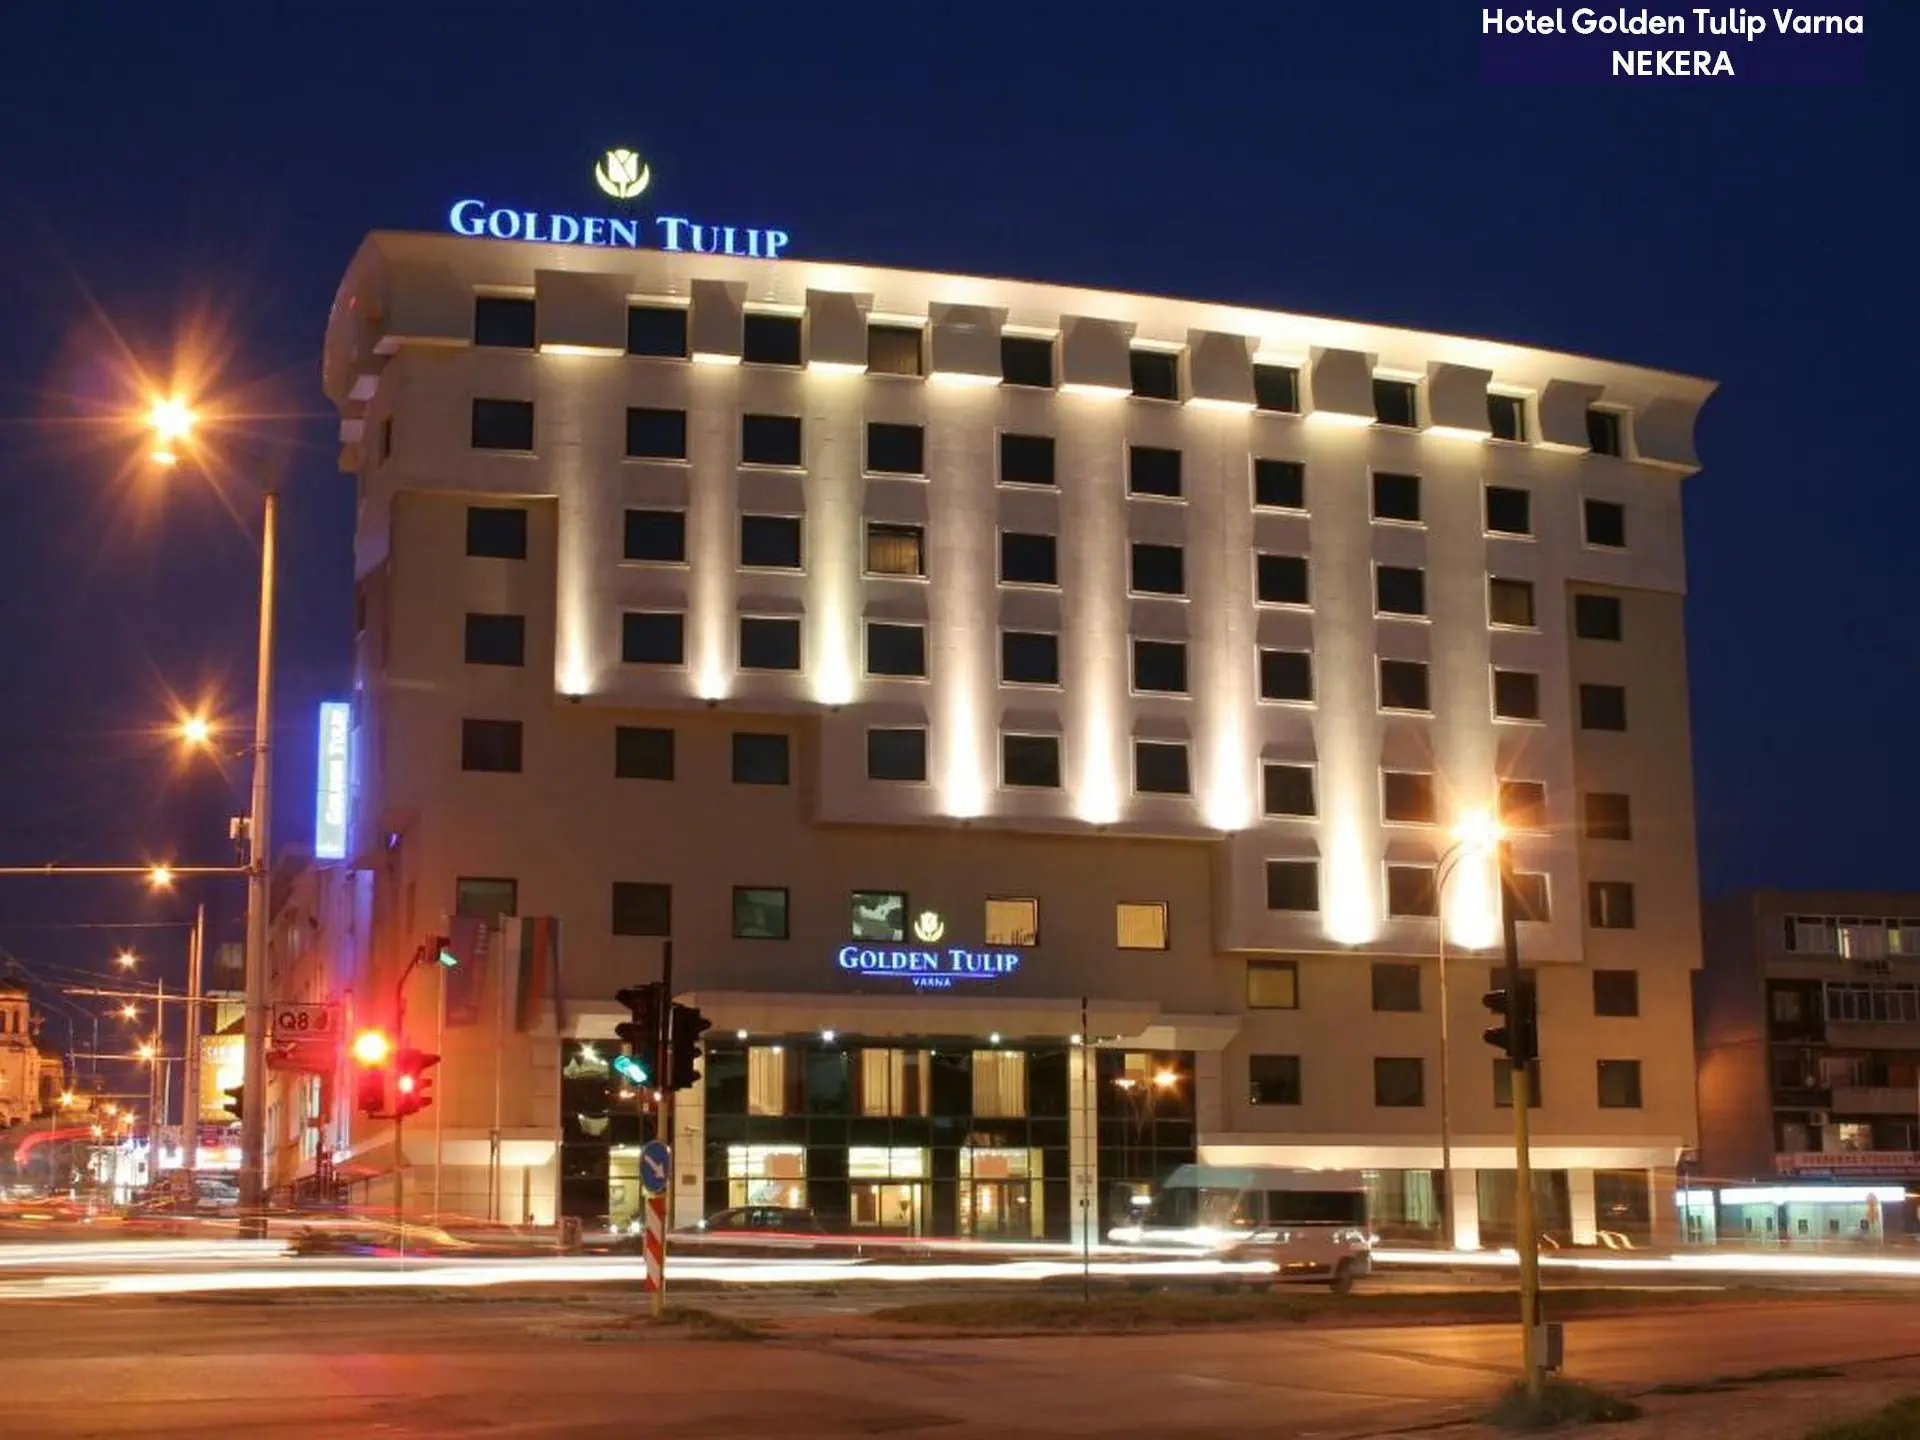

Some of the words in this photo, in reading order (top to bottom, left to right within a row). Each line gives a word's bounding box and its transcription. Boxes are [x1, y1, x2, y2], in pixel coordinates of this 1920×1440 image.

[450, 199, 638, 248] GOLDEN
[656, 216, 789, 259] TULIP
[839, 946, 939, 970] GOLDEN
[948, 949, 1019, 972] TULIP
[912, 977, 952, 987] VARNA
[278, 1011, 309, 1029] Q8
